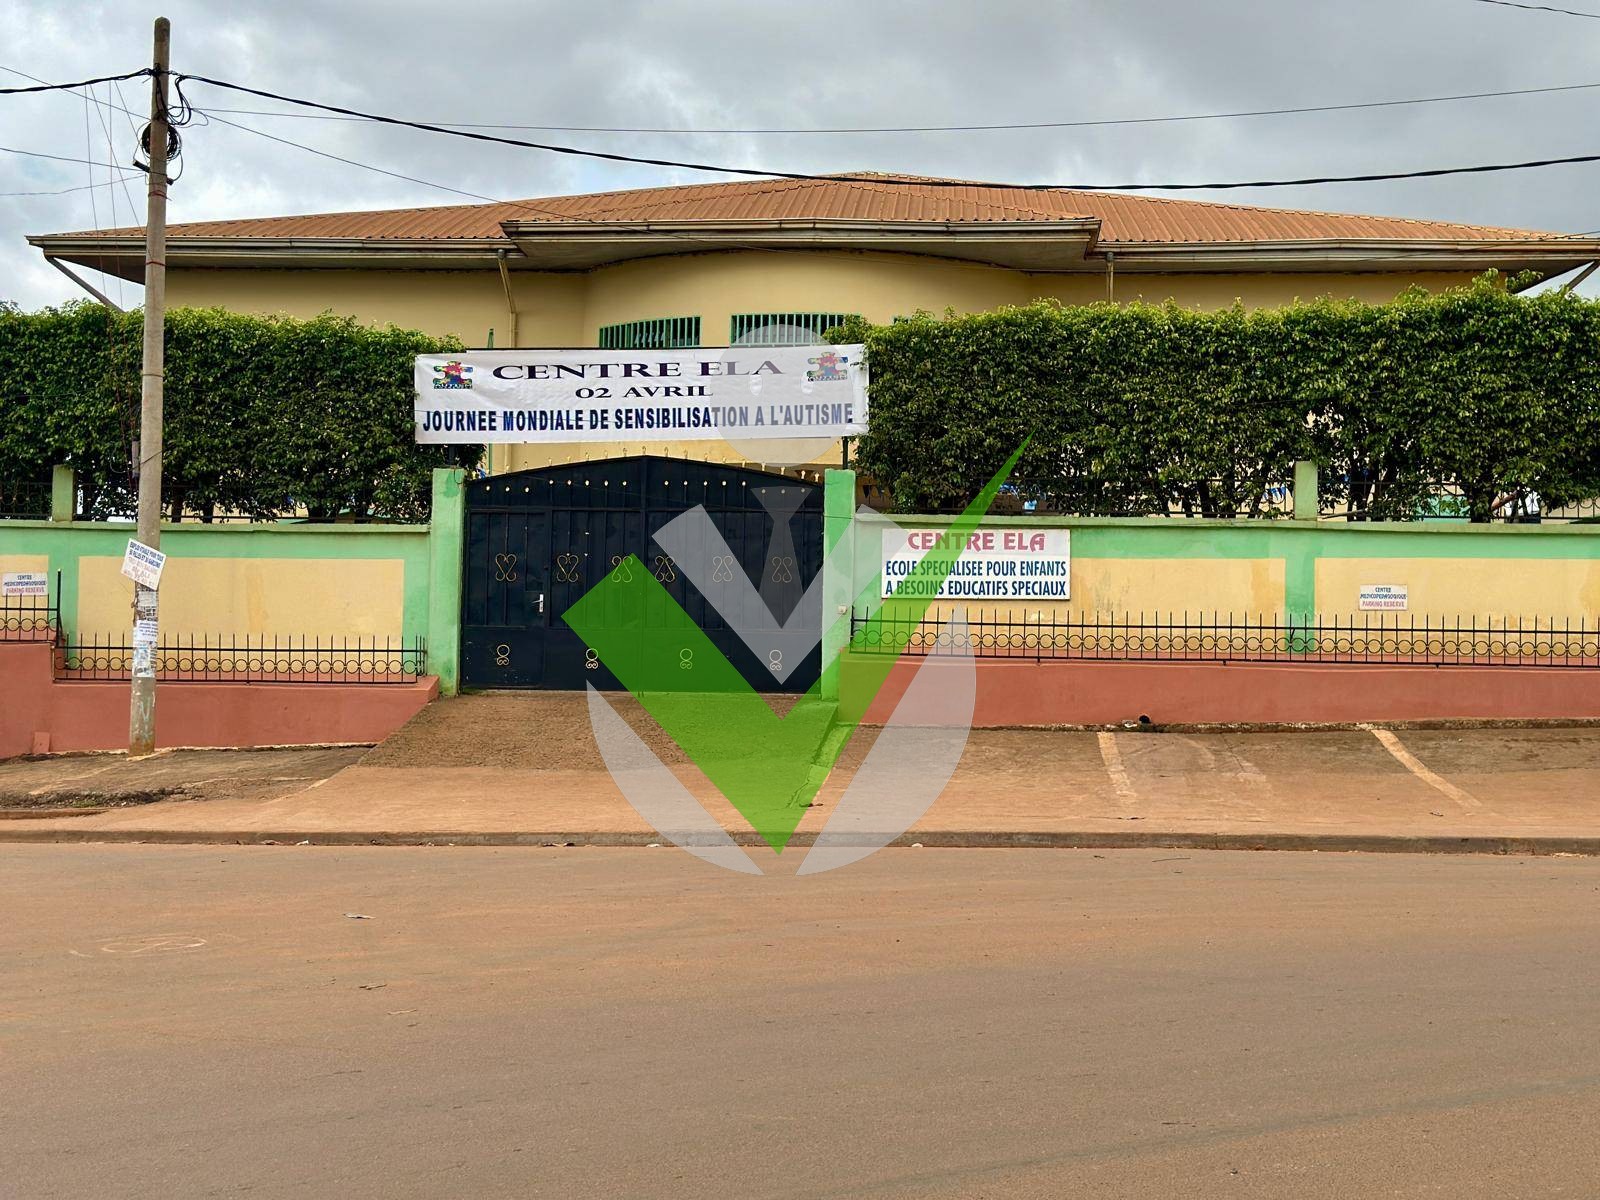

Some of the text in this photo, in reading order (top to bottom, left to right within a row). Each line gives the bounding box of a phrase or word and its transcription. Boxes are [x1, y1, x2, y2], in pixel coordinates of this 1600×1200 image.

[492, 360, 786, 380] CENTRE ELA
[575, 385, 714, 399] 02 AVRIL
[423, 403, 853, 432] JOURNEE MONDIALE DE SENSIBILISATION A L'AUTISME
[908, 532, 1046, 553] CENTRE ELA
[886, 560, 1067, 576] ECOLE SPECIALISEE POUR ENFANTS
[885, 581, 1066, 596] A BESOINS EDUCATIFS SPECIAUX
